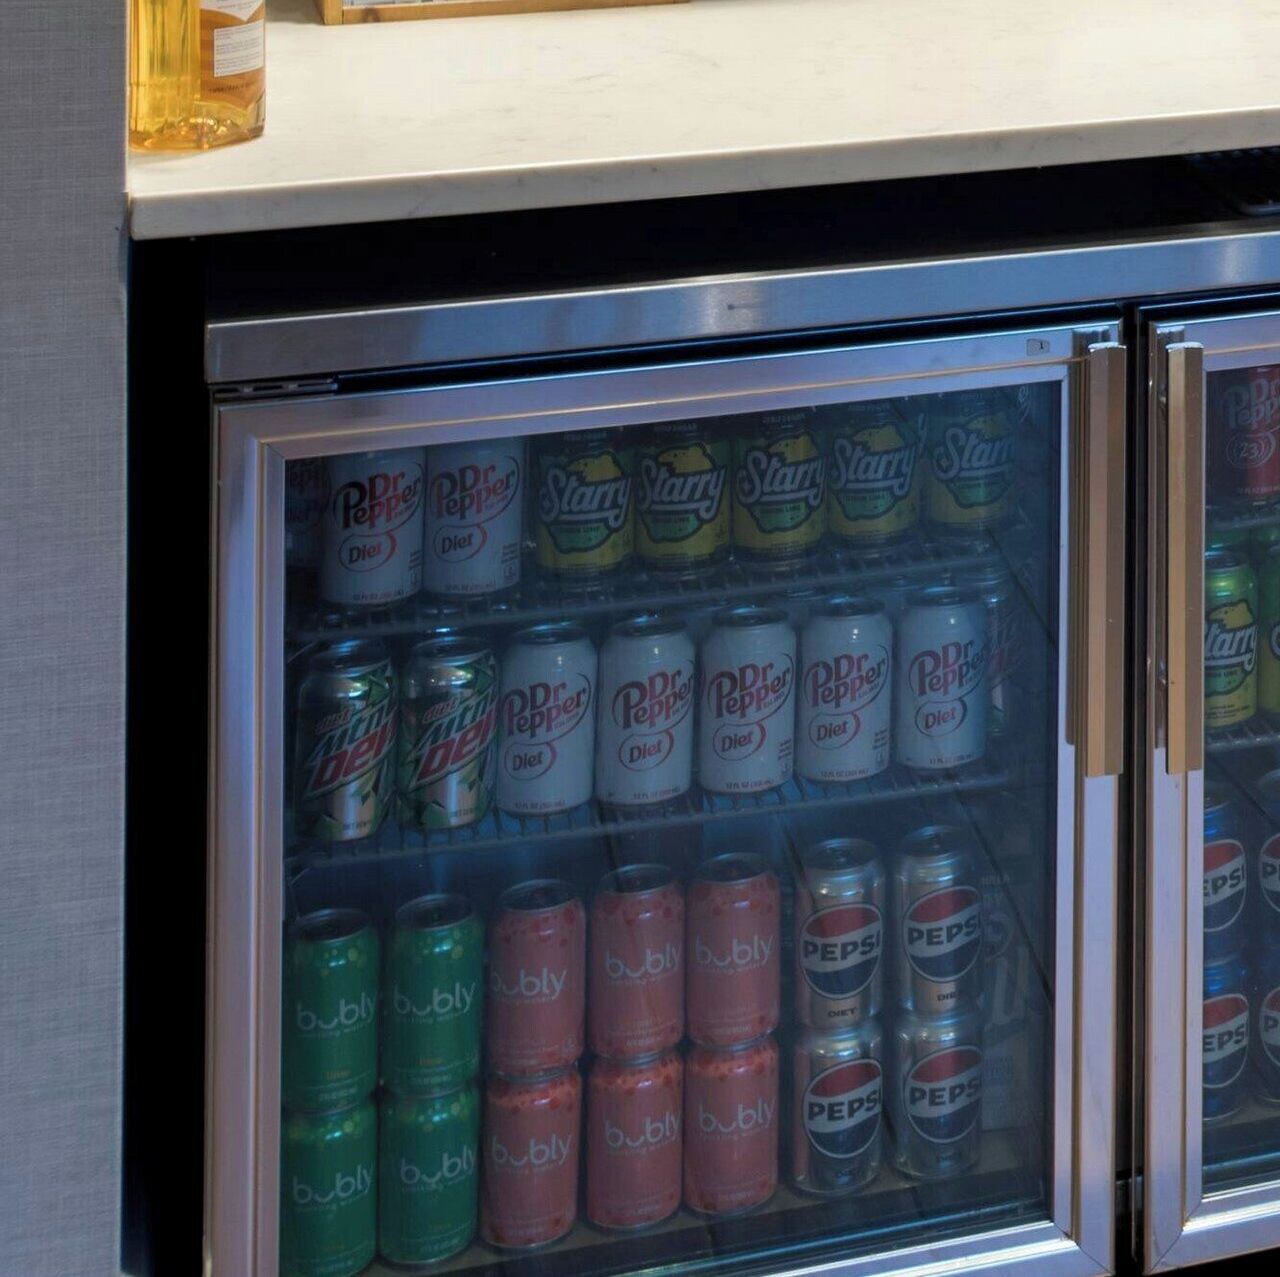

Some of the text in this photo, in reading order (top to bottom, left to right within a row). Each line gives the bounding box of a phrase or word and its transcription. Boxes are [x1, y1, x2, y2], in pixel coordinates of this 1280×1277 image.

[1240, 442, 1260, 458] 23
[369, 470, 406, 502] Dr
[459, 464, 496, 493] Dr
[641, 459, 727, 520] Starry
[336, 477, 421, 530] Pepper
[431, 469, 515, 520] Pepper
[543, 462, 632, 528] Starry
[348, 542, 383, 565] Diet
[441, 531, 474, 555] Diet
[834, 654, 868, 684] Dr
[941, 642, 974, 668] Dr
[649, 667, 682, 700] Dr
[708, 668, 790, 719] Pepper
[738, 663, 771, 694] Dr
[804, 658, 886, 708] Pepper
[504, 688, 587, 738] Pepper
[530, 683, 566, 714] Dr
[613, 673, 695, 730] Pepper
[815, 720, 848, 740] Diet
[924, 706, 957, 726] Diet
[629, 738, 662, 762] Diet
[720, 730, 754, 751] Diet
[512, 751, 543, 770] Diet
[605, 942, 681, 978] bubly
[694, 935, 772, 966] bubly
[803, 933, 879, 962] PEPSI
[296, 991, 377, 1031] bubly
[393, 980, 476, 1015] bubly
[808, 1092, 881, 1122] PEPSI
[909, 1080, 983, 1108] PEPS
[605, 1109, 681, 1147] bubly
[698, 1099, 775, 1133] bubly
[400, 1143, 476, 1185] bubly
[491, 1134, 572, 1165] bubly
[292, 1163, 374, 1204] bubly
